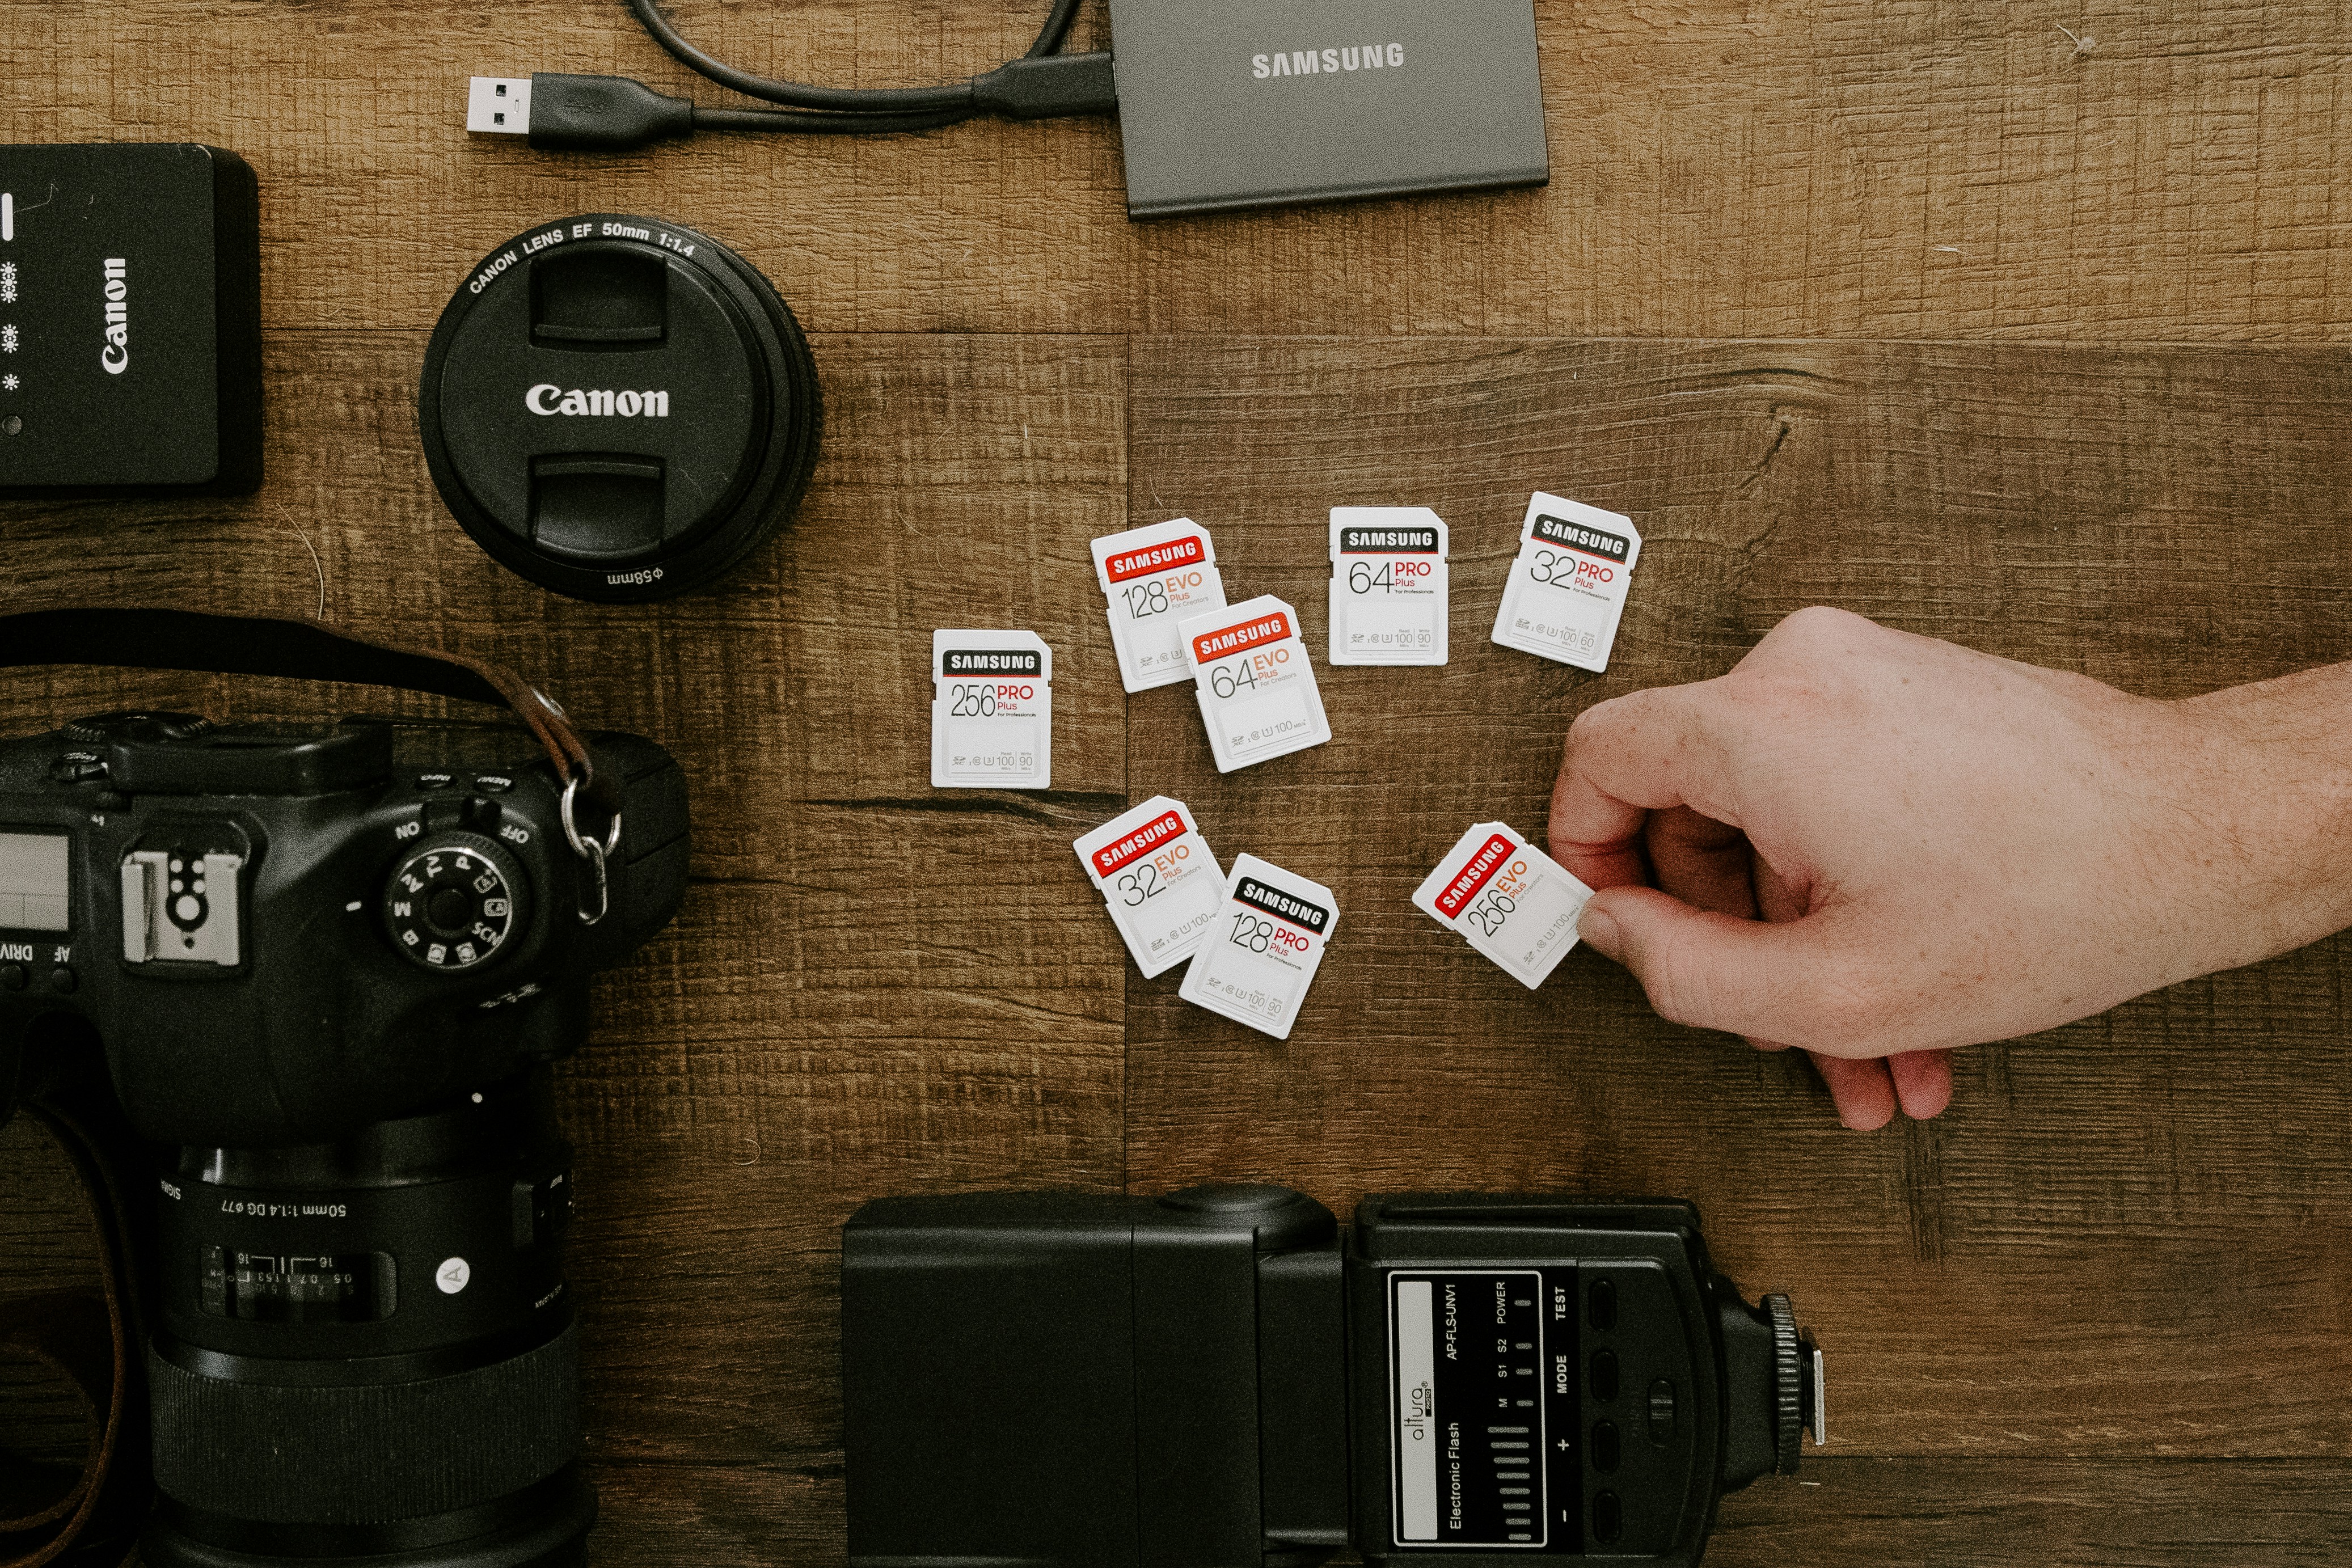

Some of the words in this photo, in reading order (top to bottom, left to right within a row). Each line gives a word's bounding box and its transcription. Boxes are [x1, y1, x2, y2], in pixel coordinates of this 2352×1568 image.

[1252, 43, 1404, 79] SAMSUNG
[470, 250, 517, 294] CANON
[522, 229, 564, 254] LENS
[572, 223, 593, 239] EF
[602, 223, 650, 240] 50mm
[659, 233, 695, 257] 1:1.4
[102, 258, 128, 374] Canon
[526, 384, 668, 417] Canon
[1349, 532, 1432, 546] SAMSUNG
[1542, 520, 1624, 555] SAMSUNG
[1114, 542, 1196, 573] SAMSUNG
[1349, 561, 1395, 594] 64
[1395, 562, 1431, 576] PRO
[1531, 550, 1576, 590] 32
[1577, 561, 1613, 582] PRO
[1574, 577, 1594, 589] Plus
[1122, 581, 1168, 619] 128
[1166, 572, 1202, 592] EVO
[1170, 593, 1190, 603] Plus
[1201, 619, 1282, 654] SAMSUNG
[1395, 633, 1412, 643] 100
[1418, 633, 1431, 643] 90
[1560, 630, 1577, 643] 100
[1581, 636, 1594, 648] 60
[951, 655, 1035, 669] SAMSUNG
[1211, 659, 1258, 699] 64
[1253, 648, 1289, 670] EVO
[1258, 670, 1278, 680] Plus
[1271, 673, 1297, 684] Creators
[951, 684, 995, 717] 256
[998, 685, 1033, 700] PRO
[1275, 721, 1293, 733] 100
[996, 756, 1015, 766] 100
[1019, 756, 1033, 766] 90
[395, 822, 420, 839] ON
[500, 825, 529, 844] OFF
[1101, 817, 1177, 867] SAMSUNG
[455, 856, 471, 870] P
[1118, 864, 1166, 906] 32
[1154, 844, 1189, 872] EVO
[1162, 867, 1182, 881] Plus
[1177, 865, 1201, 880] Creators
[1442, 841, 1504, 908] SAMSUNG
[1468, 889, 1515, 937] 256
[1496, 861, 1527, 893] EVO
[1509, 882, 1527, 899] Plus
[394, 902, 411, 917] M
[1244, 883, 1323, 925] SAMSUNG
[1191, 913, 1209, 928] 100
[1553, 914, 1569, 929] 100
[403, 929, 420, 946] B
[1230, 912, 1273, 953] 128
[1274, 927, 1309, 951] PRO
[54, 946, 70, 962] AF
[1269, 943, 1289, 956] Plus
[1248, 994, 1265, 1007] 100
[1268, 1002, 1281, 1013] 90
[247, 1202, 265, 1216] DG
[269, 1204, 298, 1217] 1:1.4
[302, 1204, 347, 1217] 50mm
[238, 1253, 249, 1265] 16
[443, 1265, 462, 1282] A
[1496, 1282, 1506, 1324] POWER
[1555, 1286, 1566, 1321] TEST
[1446, 1284, 1457, 1360] AP-FLS-UNV1
[1497, 1339, 1507, 1353] S2
[1498, 1364, 1508, 1378] S1
[1556, 1355, 1567, 1393] MODE
[1498, 1398, 1508, 1408] M
[1404, 1388, 1424, 1440] altura
[1448, 1422, 1459, 1459] Flash
[1450, 1462, 1462, 1529] Electronic
